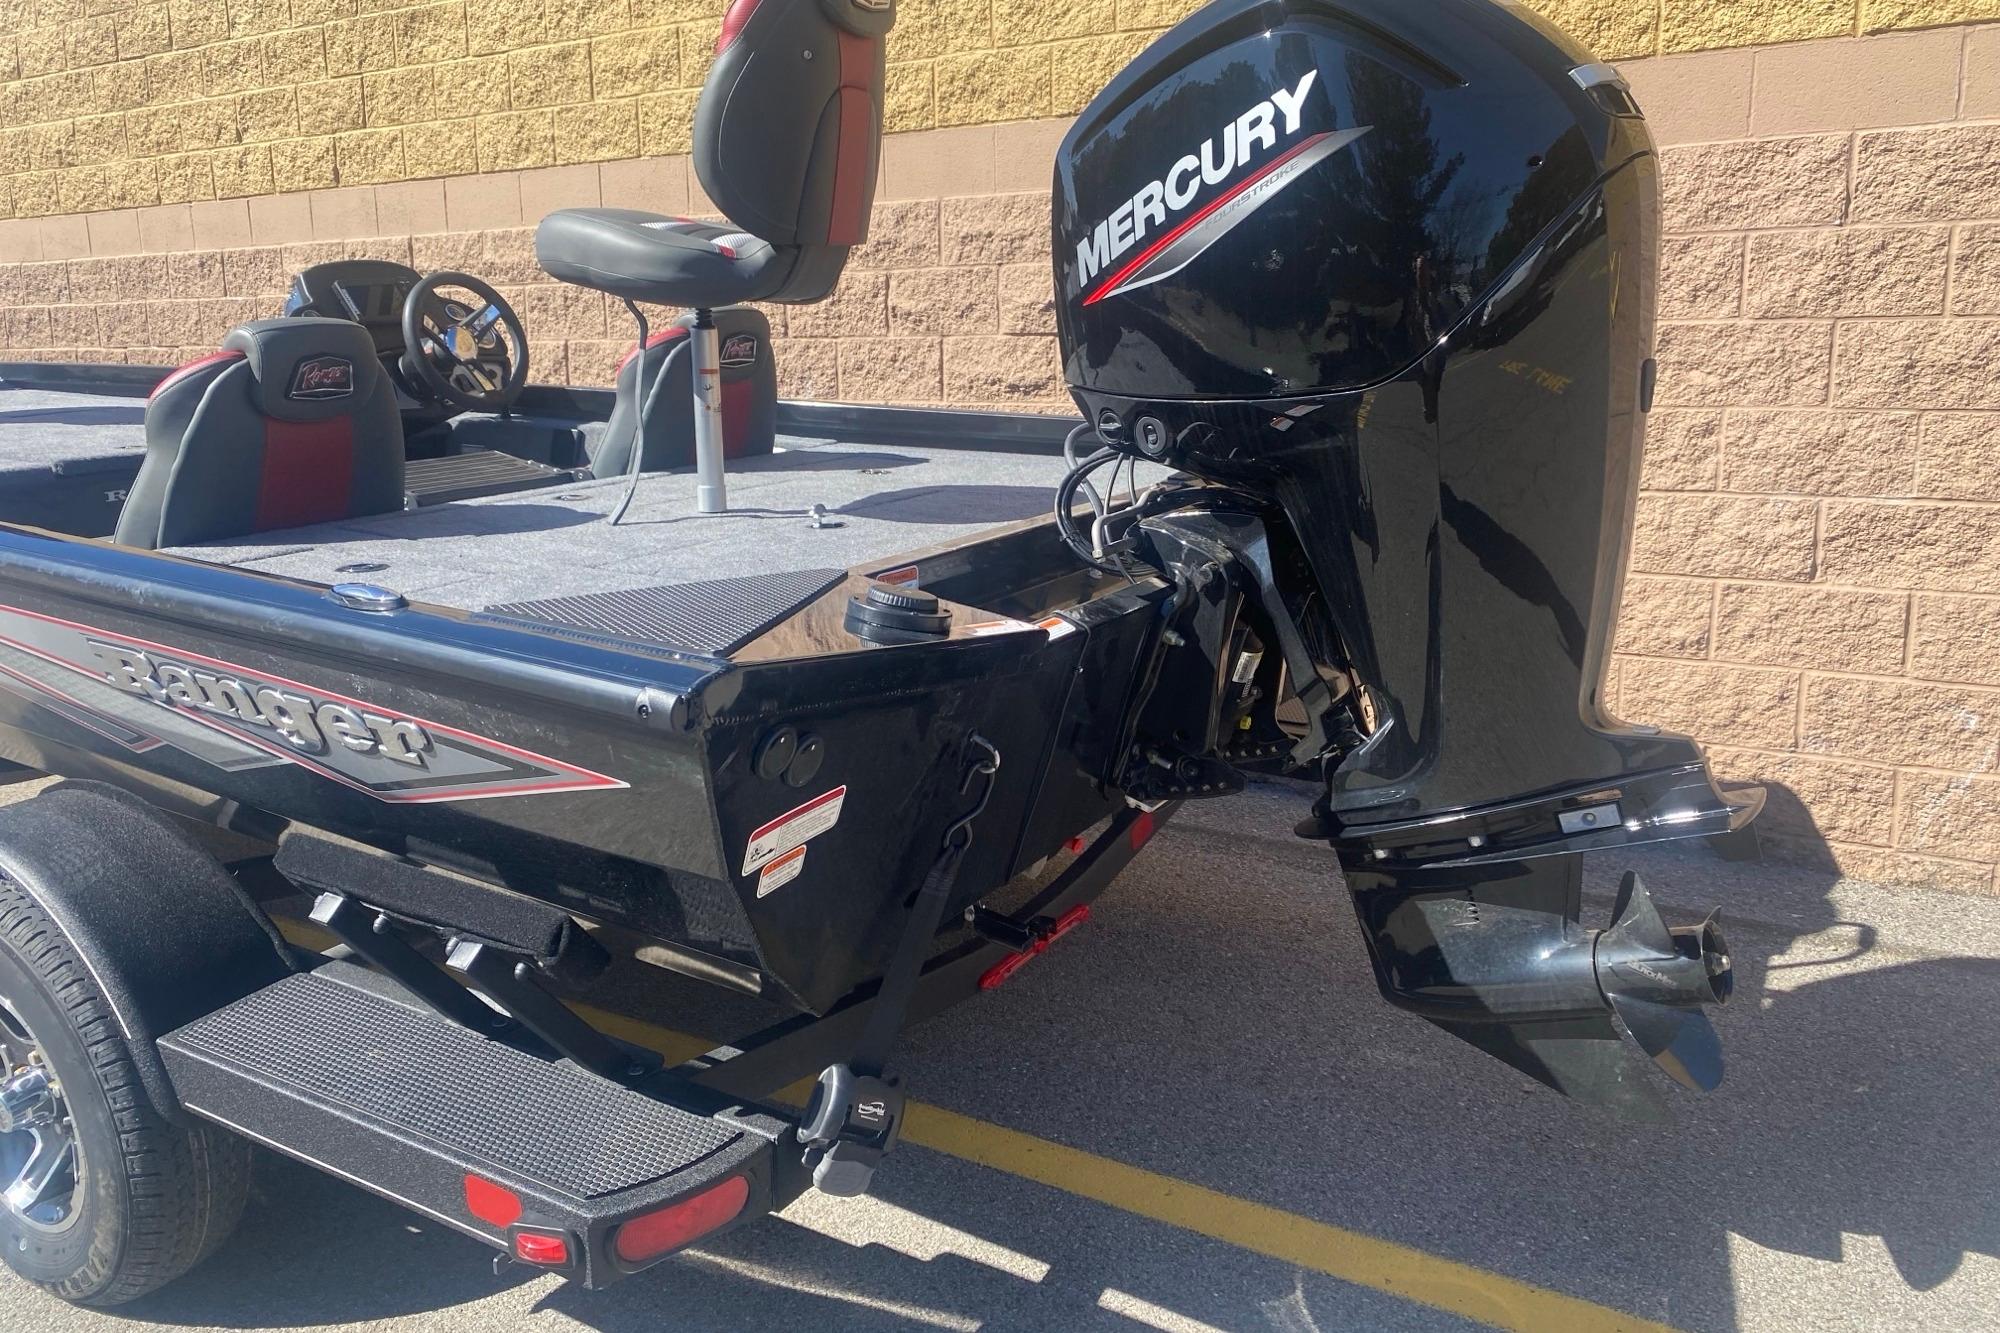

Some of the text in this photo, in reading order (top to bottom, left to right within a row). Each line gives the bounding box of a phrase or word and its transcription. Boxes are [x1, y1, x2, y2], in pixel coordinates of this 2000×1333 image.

[1076, 69, 1317, 288] MERCURY
[1203, 160, 1300, 230] FOURSTROKE
[87, 641, 433, 768] Ranger
